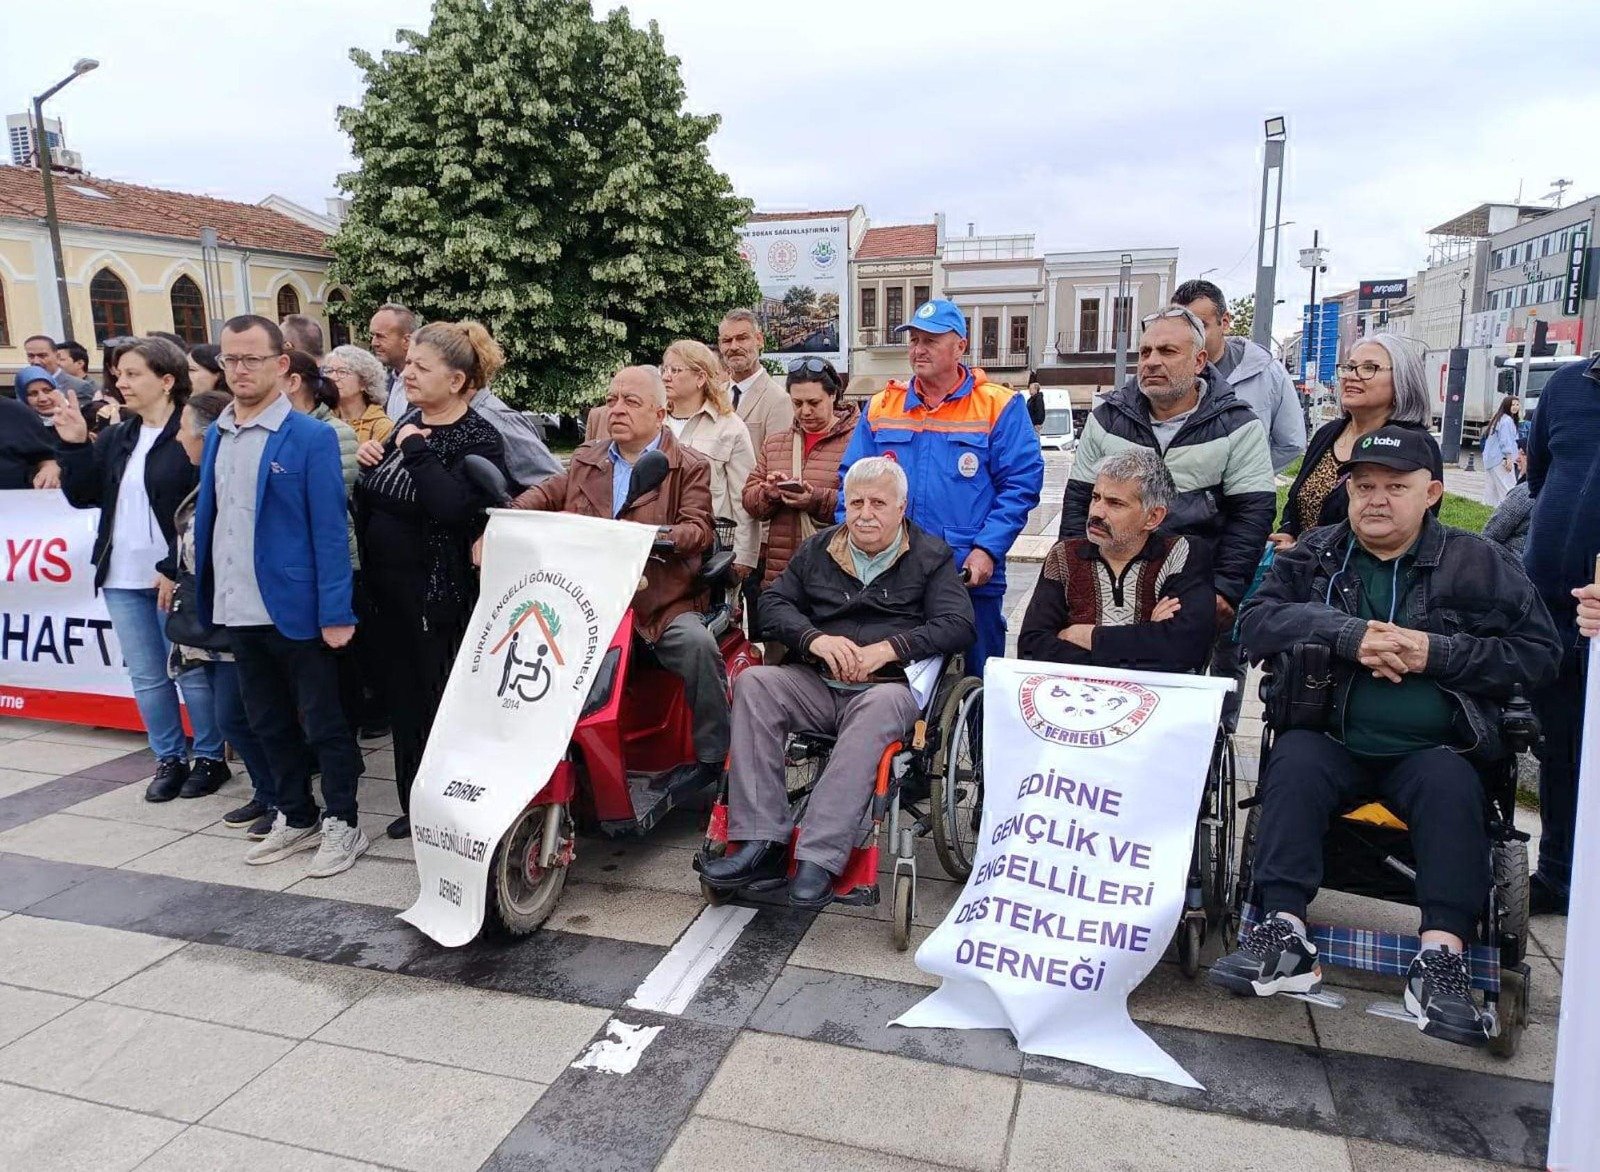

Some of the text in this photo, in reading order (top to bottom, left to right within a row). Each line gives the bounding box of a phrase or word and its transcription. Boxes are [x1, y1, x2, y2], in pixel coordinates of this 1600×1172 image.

[1372, 283, 1405, 294] arçelik
[1568, 233, 1585, 314] HOTEL
[5, 537, 72, 583] YIS
[2, 612, 129, 668] HAFT
[471, 620, 493, 674] EDİRNE
[491, 574, 529, 620] ENGELLİ
[528, 569, 599, 624] GÖNÜLLÜLERİ
[501, 697, 520, 710] 2014
[442, 779, 486, 802] EDİRNE
[1017, 768, 1123, 817] EDİRNE
[414, 825, 491, 863] ENGELLİ GÖNÜLLÜLERİ
[991, 812, 1152, 870] GENÇLİK VE
[974, 854, 1155, 906] ENGELLİLERİ
[954, 896, 1151, 952] DESTEKLEME
[956, 939, 1106, 991] DERNEĞİ
